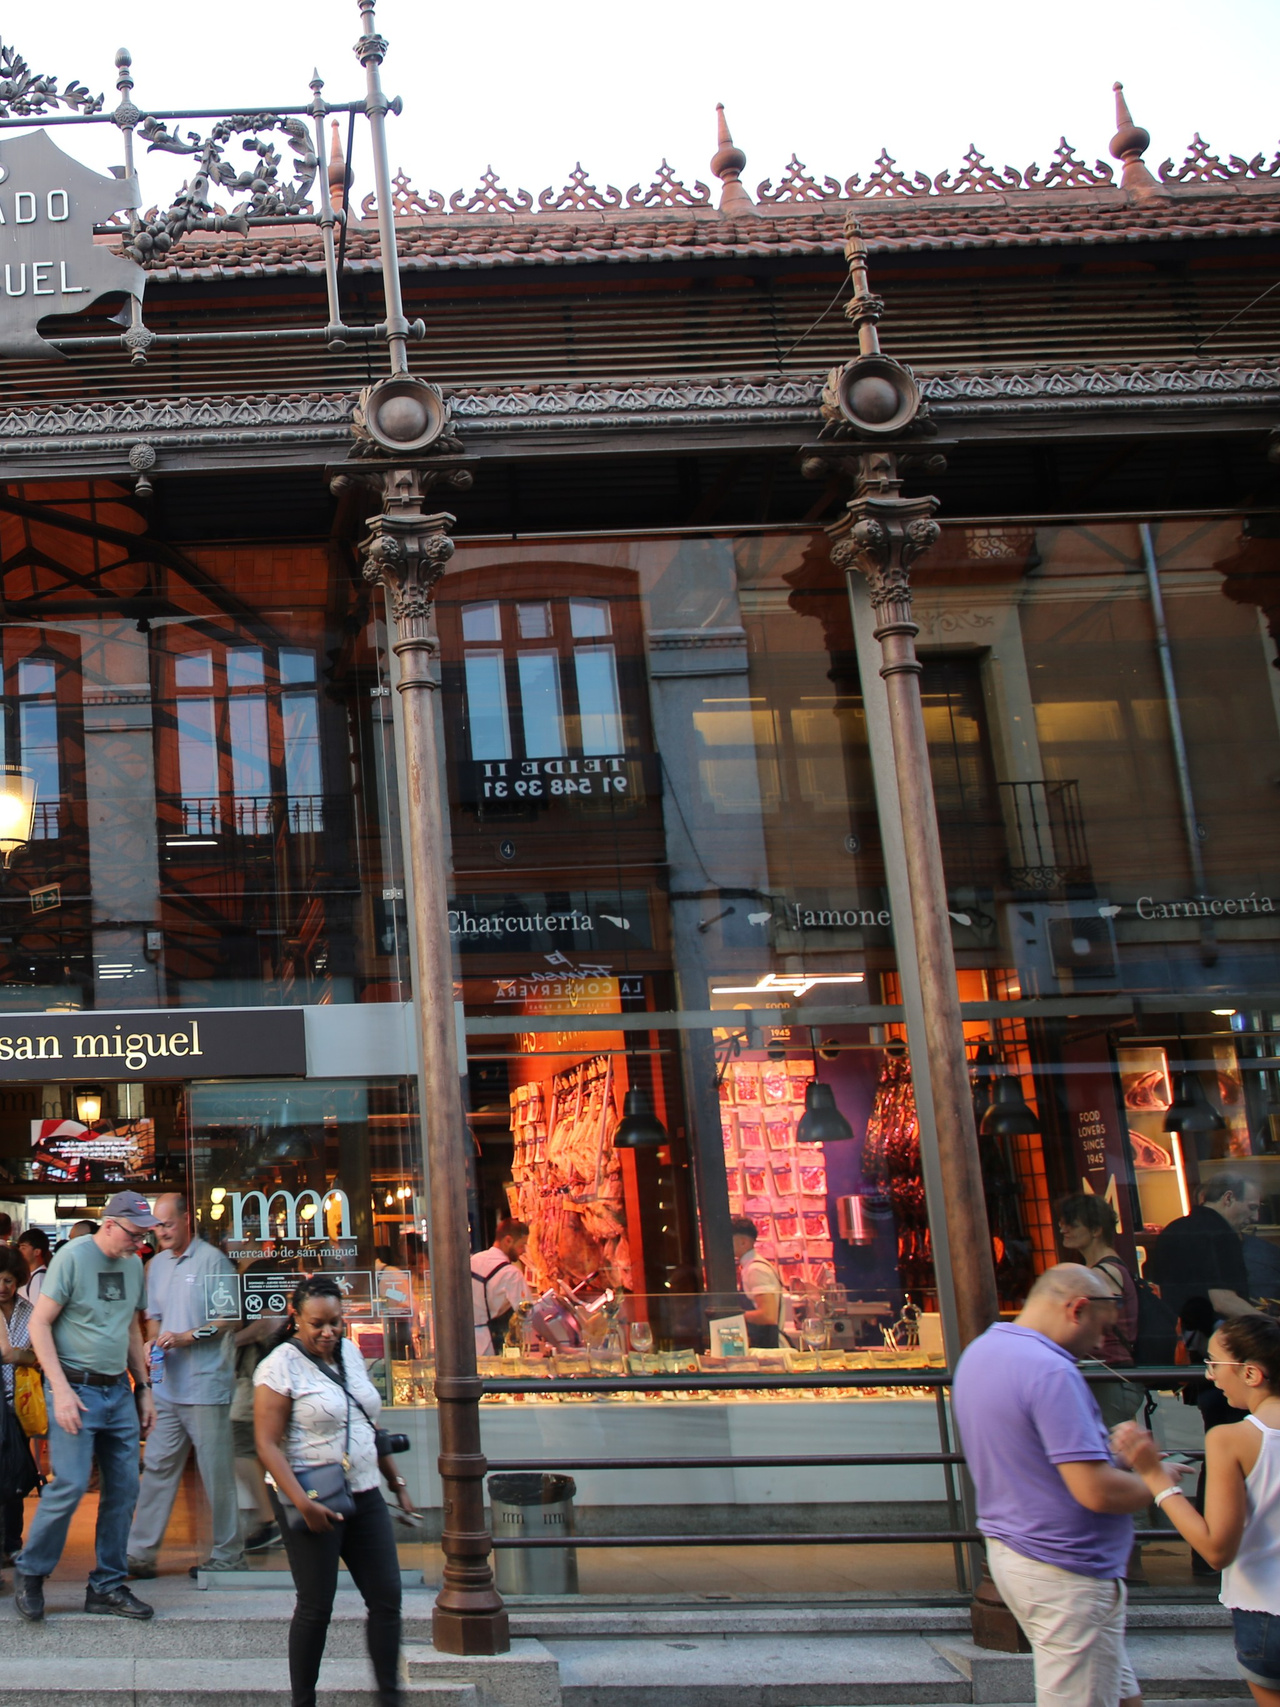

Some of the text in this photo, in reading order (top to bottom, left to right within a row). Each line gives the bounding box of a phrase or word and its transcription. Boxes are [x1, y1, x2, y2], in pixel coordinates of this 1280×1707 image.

[1136, 892, 1276, 920] Carnicería
[447, 909, 594, 934] Charcutería
[792, 903, 891, 931] Jamone
[770, 1028, 791, 1037] 1945
[72, 1020, 204, 1071] miguel
[1079, 1110, 1101, 1122] FOOD
[1078, 1124, 1106, 1138] LOVERS
[1082, 1138, 1106, 1151] SINCE
[1087, 1153, 1104, 1165] 1945
[228, 1245, 359, 1260] mercado de san miguel
